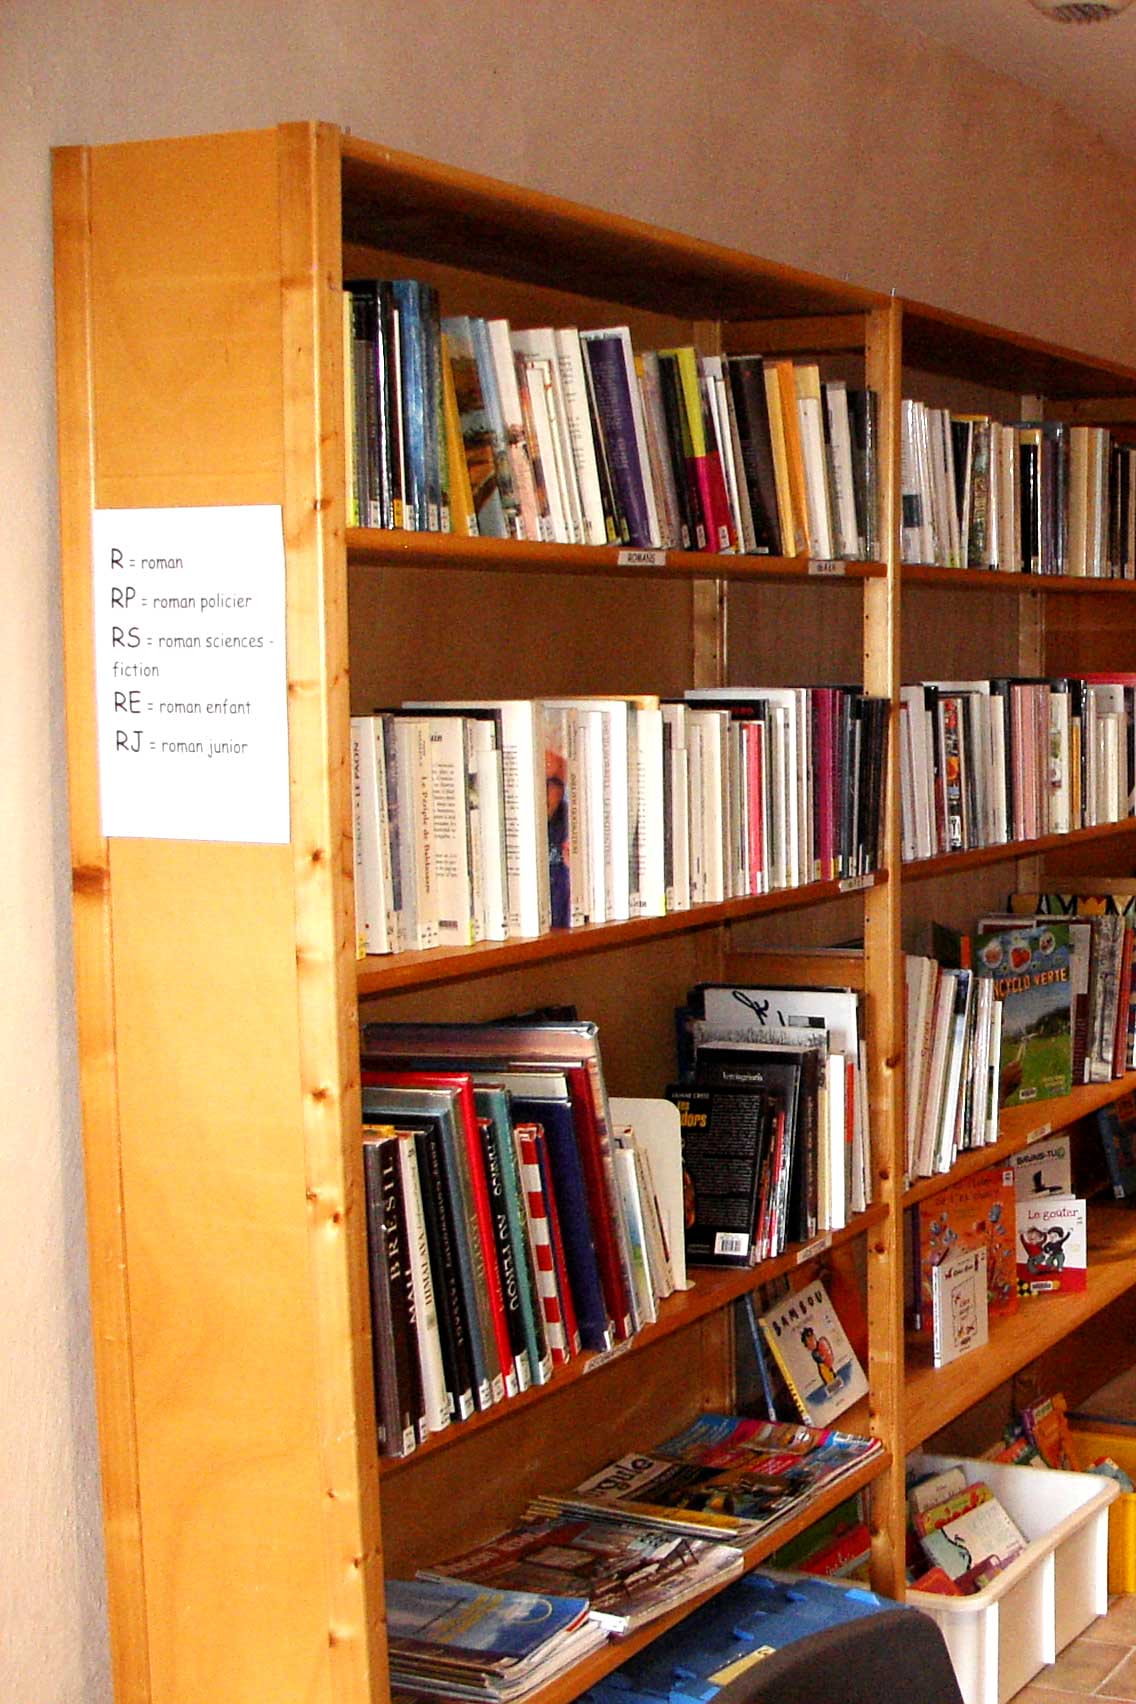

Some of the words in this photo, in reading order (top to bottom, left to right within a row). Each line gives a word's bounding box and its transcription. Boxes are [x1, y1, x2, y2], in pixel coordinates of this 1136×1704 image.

[111, 548, 123, 569] R
[142, 559, 183, 569] roman
[111, 587, 136, 608] RP
[154, 598, 195, 608] roman
[201, 593, 252, 612] policier
[112, 626, 140, 648] RS
[159, 637, 200, 648] roman
[206, 634, 263, 648] sciences
[113, 662, 159, 677] fiction
[114, 691, 141, 713] RE
[160, 703, 201, 713] roman
[207, 699, 250, 714] enfant
[116, 730, 143, 752] RJ
[162, 742, 203, 752] roman
[208, 739, 248, 758] junior
[1034, 967, 1068, 985] VERTE
[1028, 1209, 1040, 1220] Le
